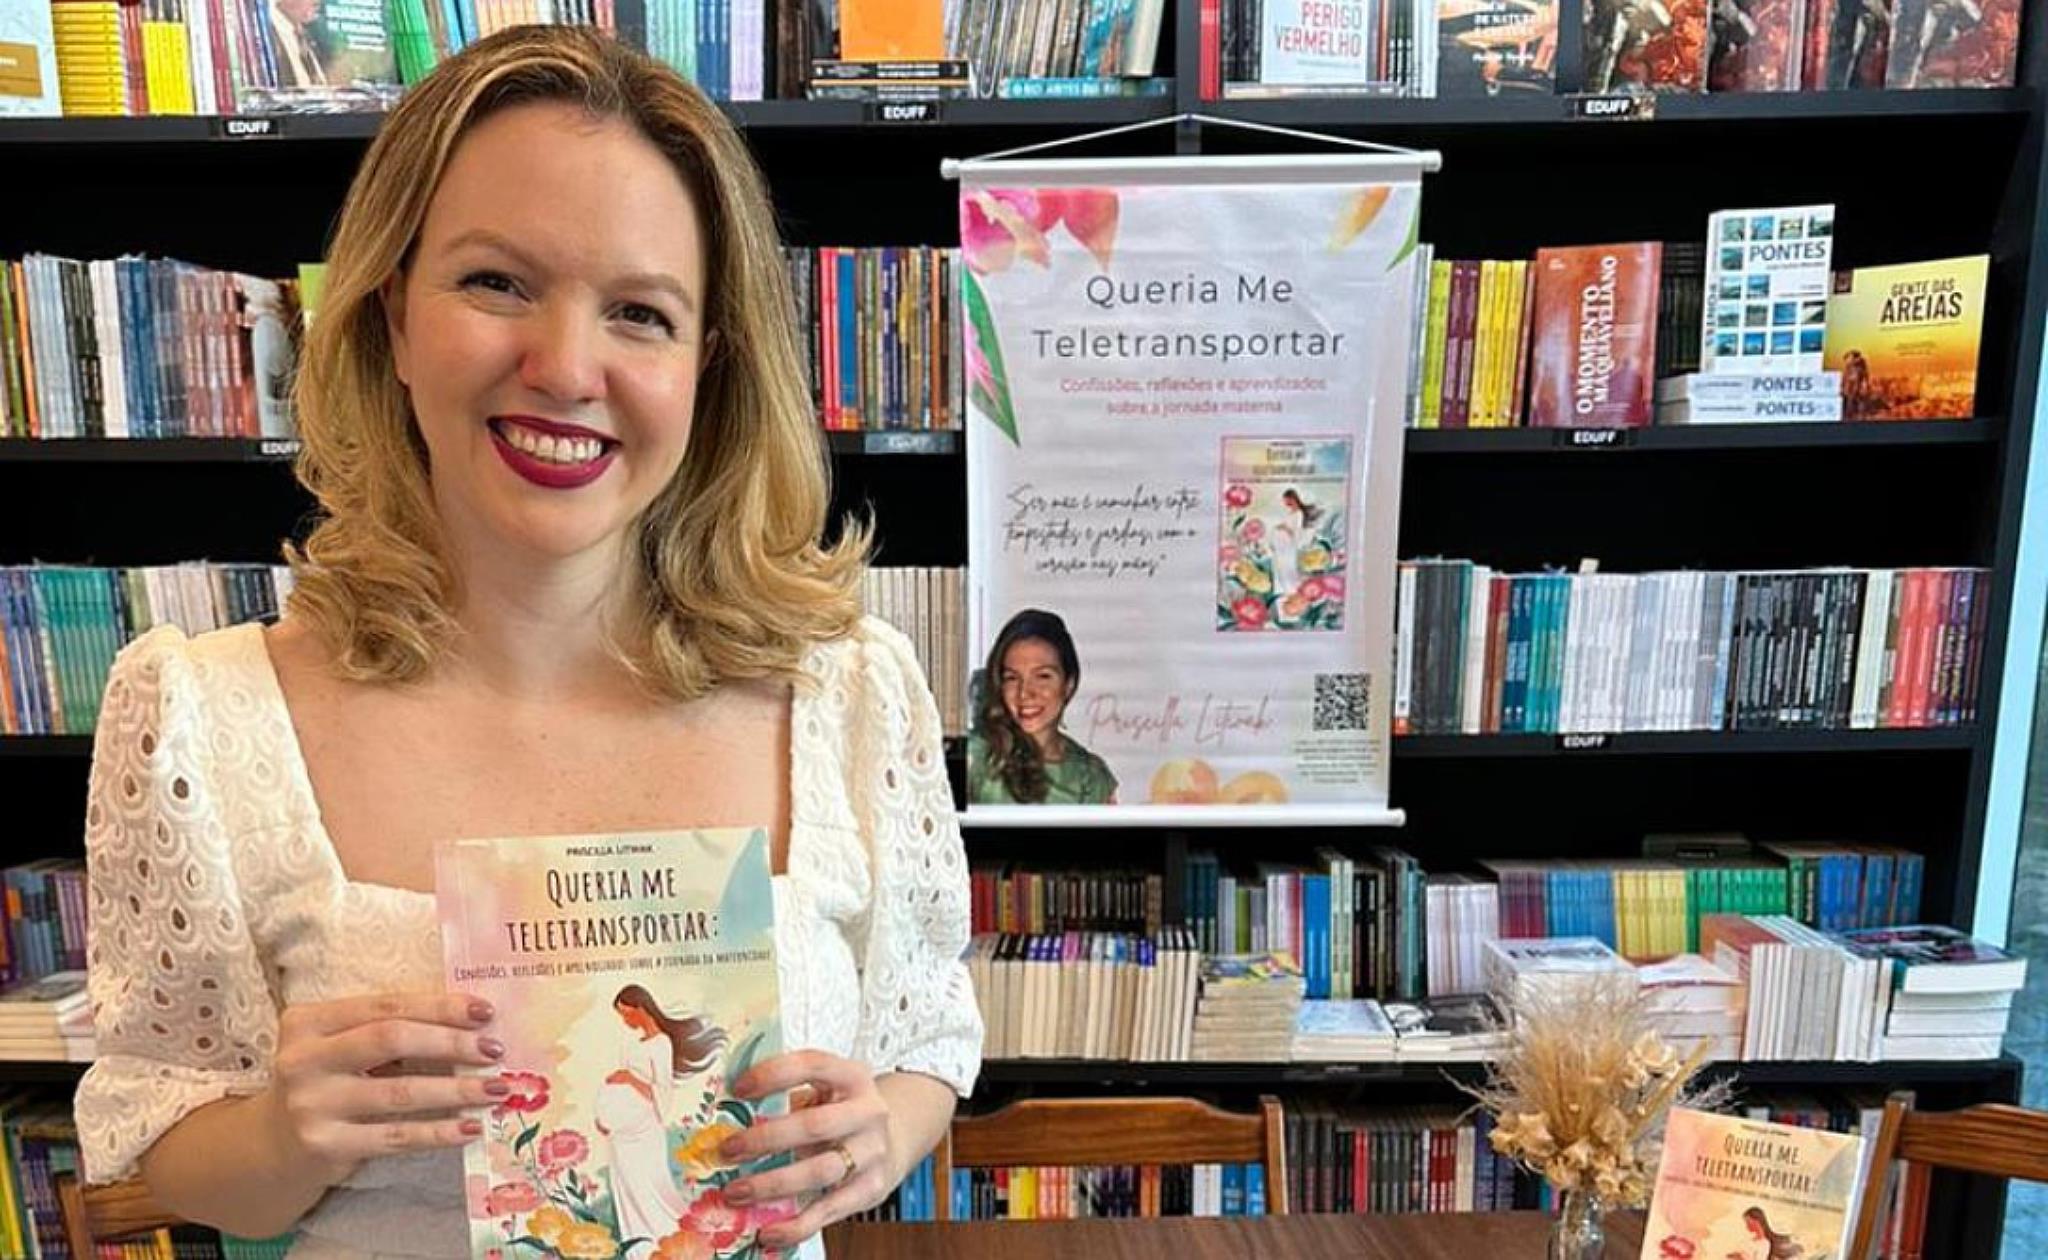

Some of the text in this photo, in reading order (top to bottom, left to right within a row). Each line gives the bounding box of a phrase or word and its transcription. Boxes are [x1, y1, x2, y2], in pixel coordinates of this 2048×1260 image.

[1302, 1, 1362, 29] PERIGO
[1275, 24, 1362, 57] VERMELHO
[883, 105, 927, 120] EDUFF
[1586, 99, 1630, 114] EDUFF
[228, 120, 270, 134] EDUFF
[1750, 241, 1826, 262] PONTES
[1086, 275, 1294, 309] Queria Me
[1891, 277, 1956, 297] GENTE DAS
[1880, 291, 1963, 324] AREIAS
[1032, 328, 1346, 362] Teletransportar
[1576, 285, 1601, 398] MOMENTO
[1752, 376, 1813, 392] PONTES
[1755, 400, 1815, 416] PONTES
[1574, 431, 1616, 444] EDUFF
[1564, 734, 1605, 748] EDUFF
[546, 867, 677, 909] QUERIA ME
[505, 911, 719, 952] TELETRANSPORTAR:
[1723, 1133, 1800, 1165] QUERIA ME
